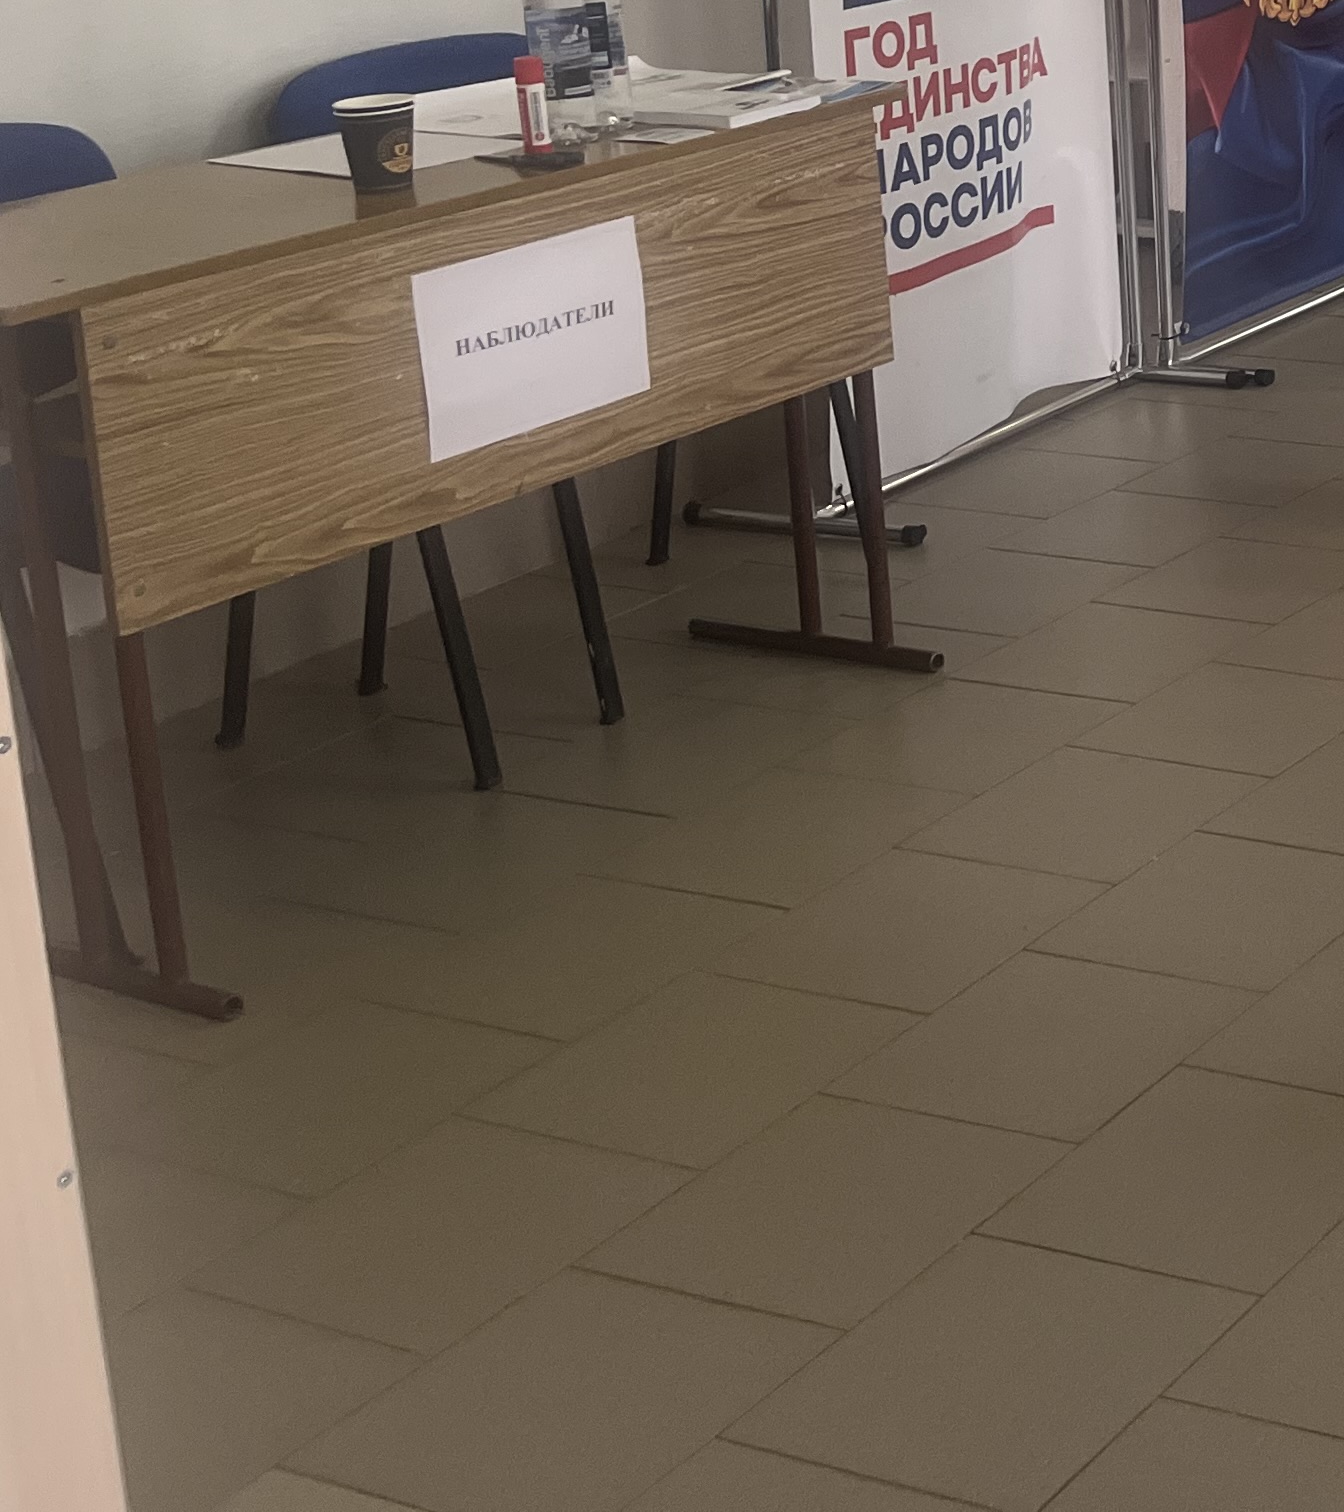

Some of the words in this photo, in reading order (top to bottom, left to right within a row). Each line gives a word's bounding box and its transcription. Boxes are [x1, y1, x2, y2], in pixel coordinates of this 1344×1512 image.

[844, 11, 938, 77] ГОД
[878, 36, 1048, 141] ДИНСТВА
[882, 160, 1022, 250] ОССИИ
[455, 299, 615, 357] НАБЛЮДАТЕЛИ
